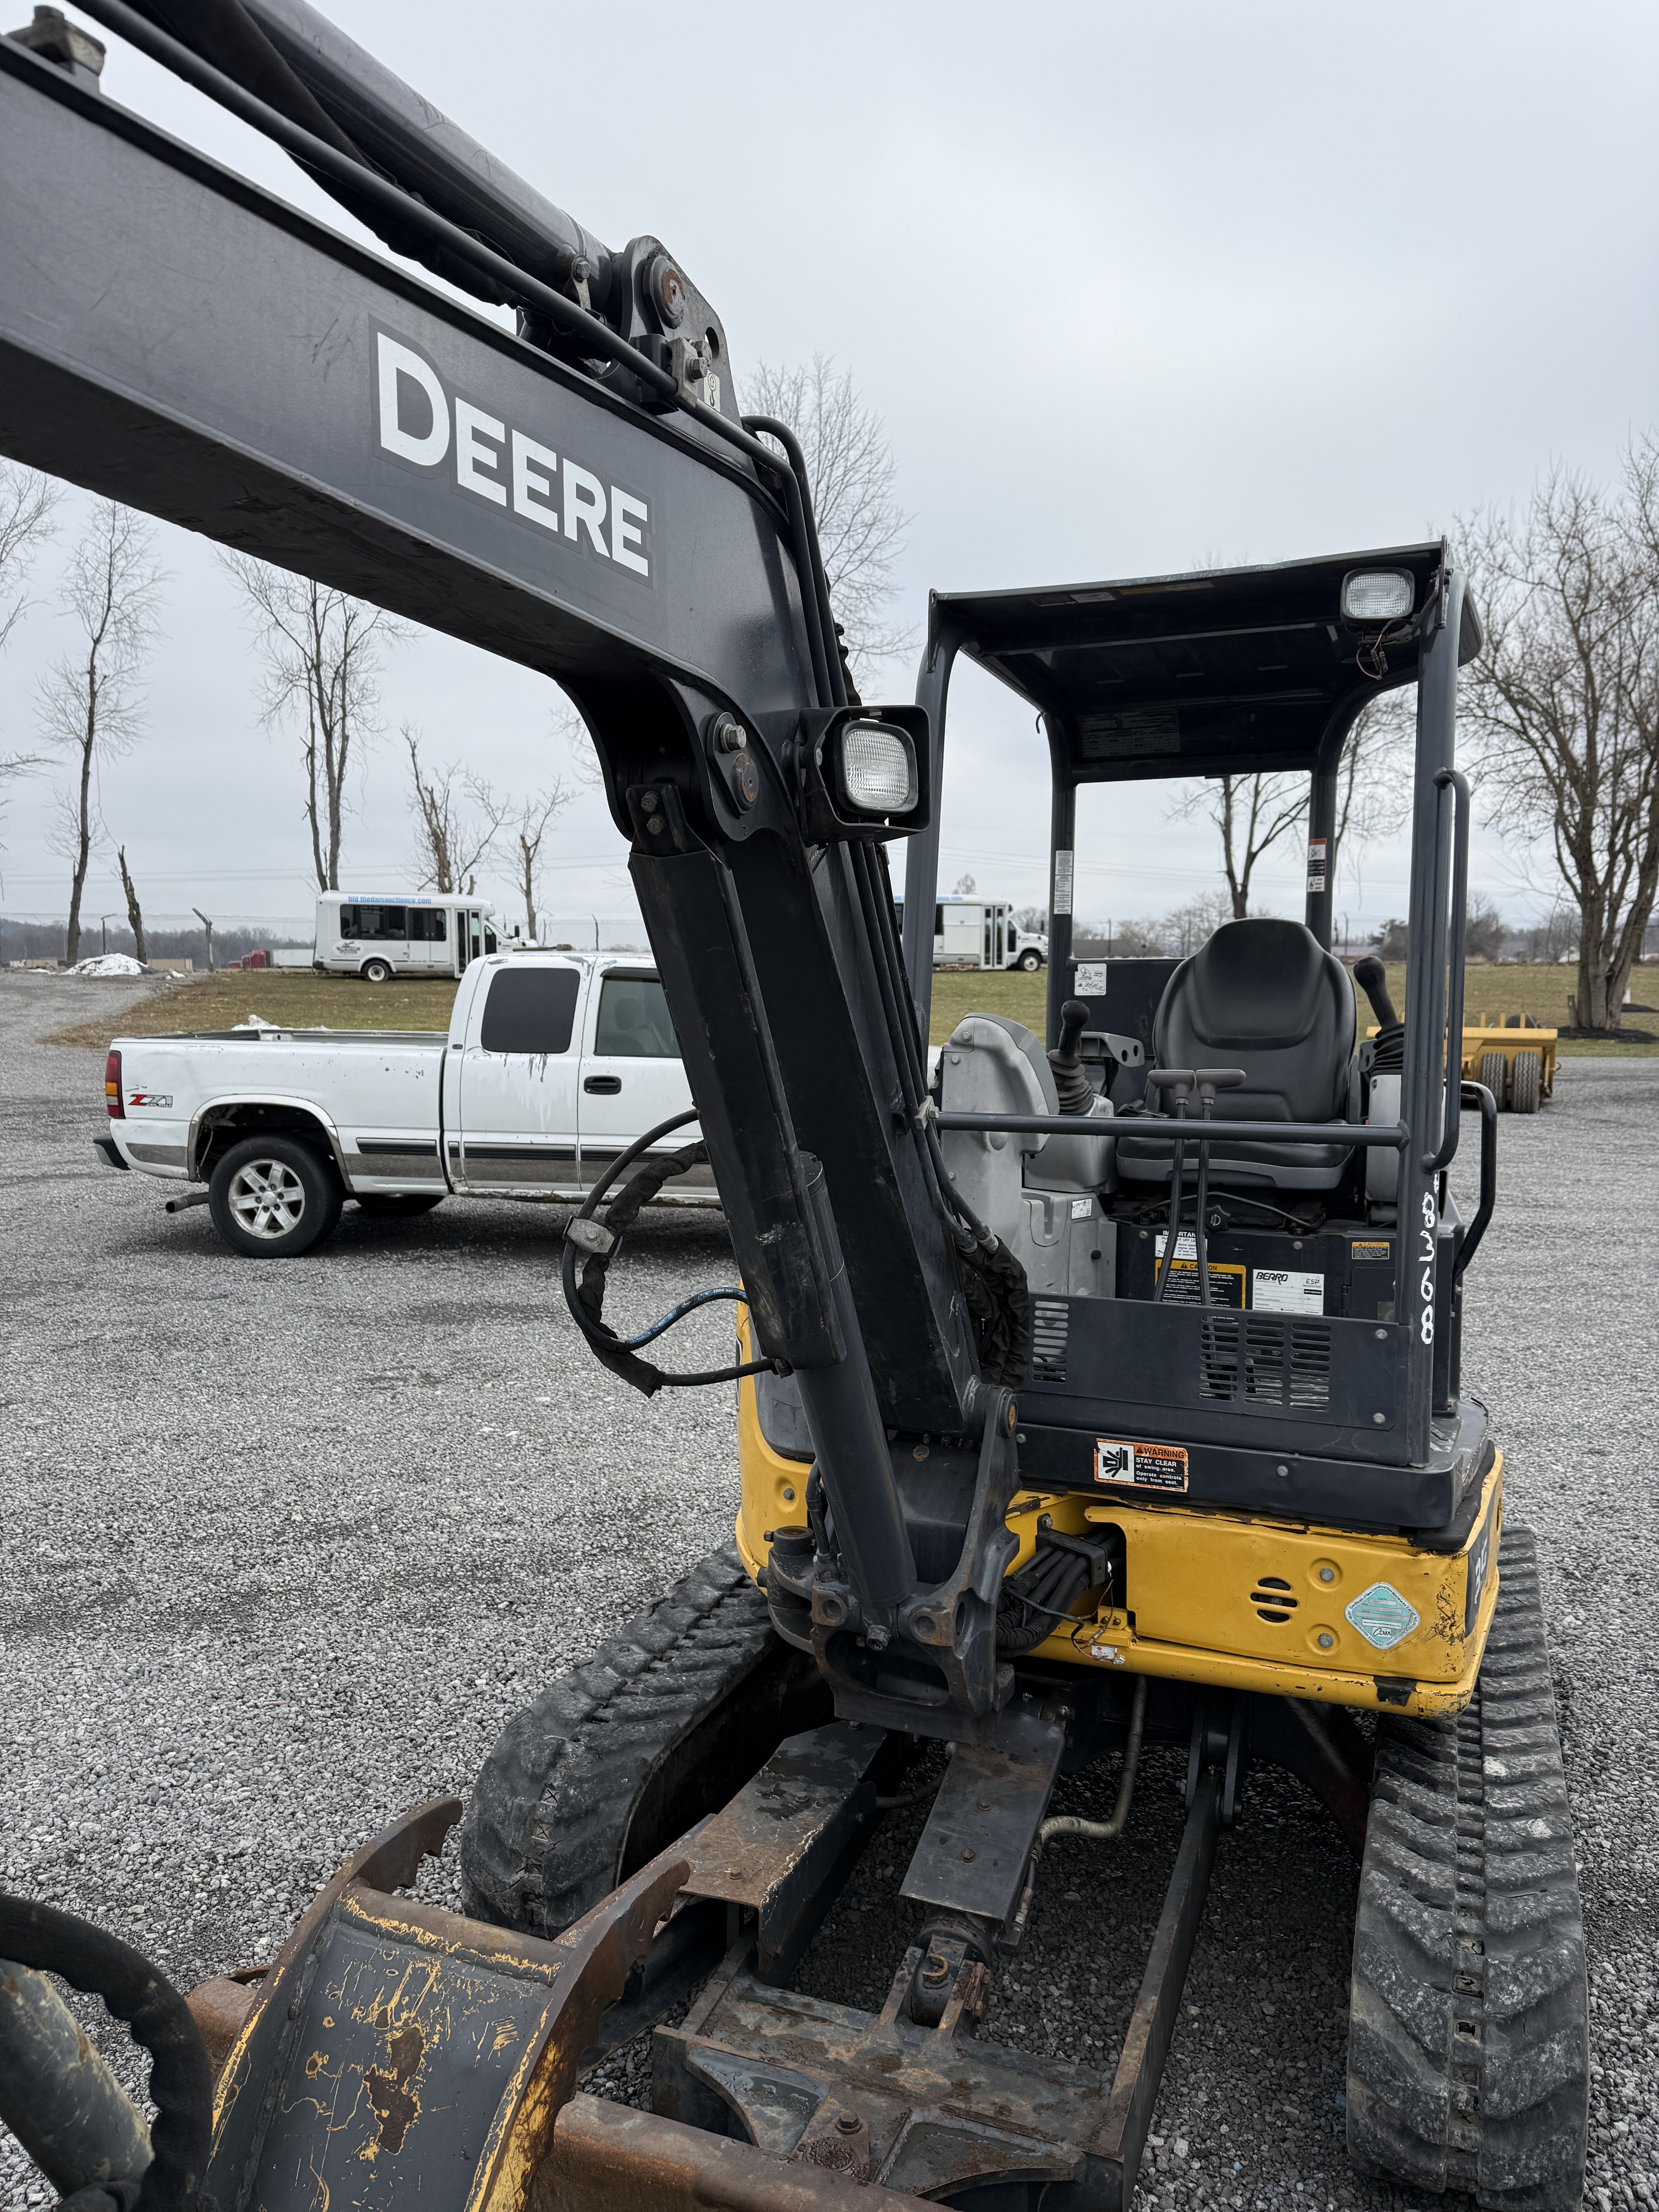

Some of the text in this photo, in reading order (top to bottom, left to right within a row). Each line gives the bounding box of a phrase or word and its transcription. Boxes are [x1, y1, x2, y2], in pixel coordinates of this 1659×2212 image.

[377, 332, 649, 577] DEERE
[128, 1094, 173, 1107] Z71
[1256, 1272, 1288, 1285] BEARD
[1145, 1448, 1184, 1458] WARNING
[1155, 1458, 1176, 1467] CLEAR
